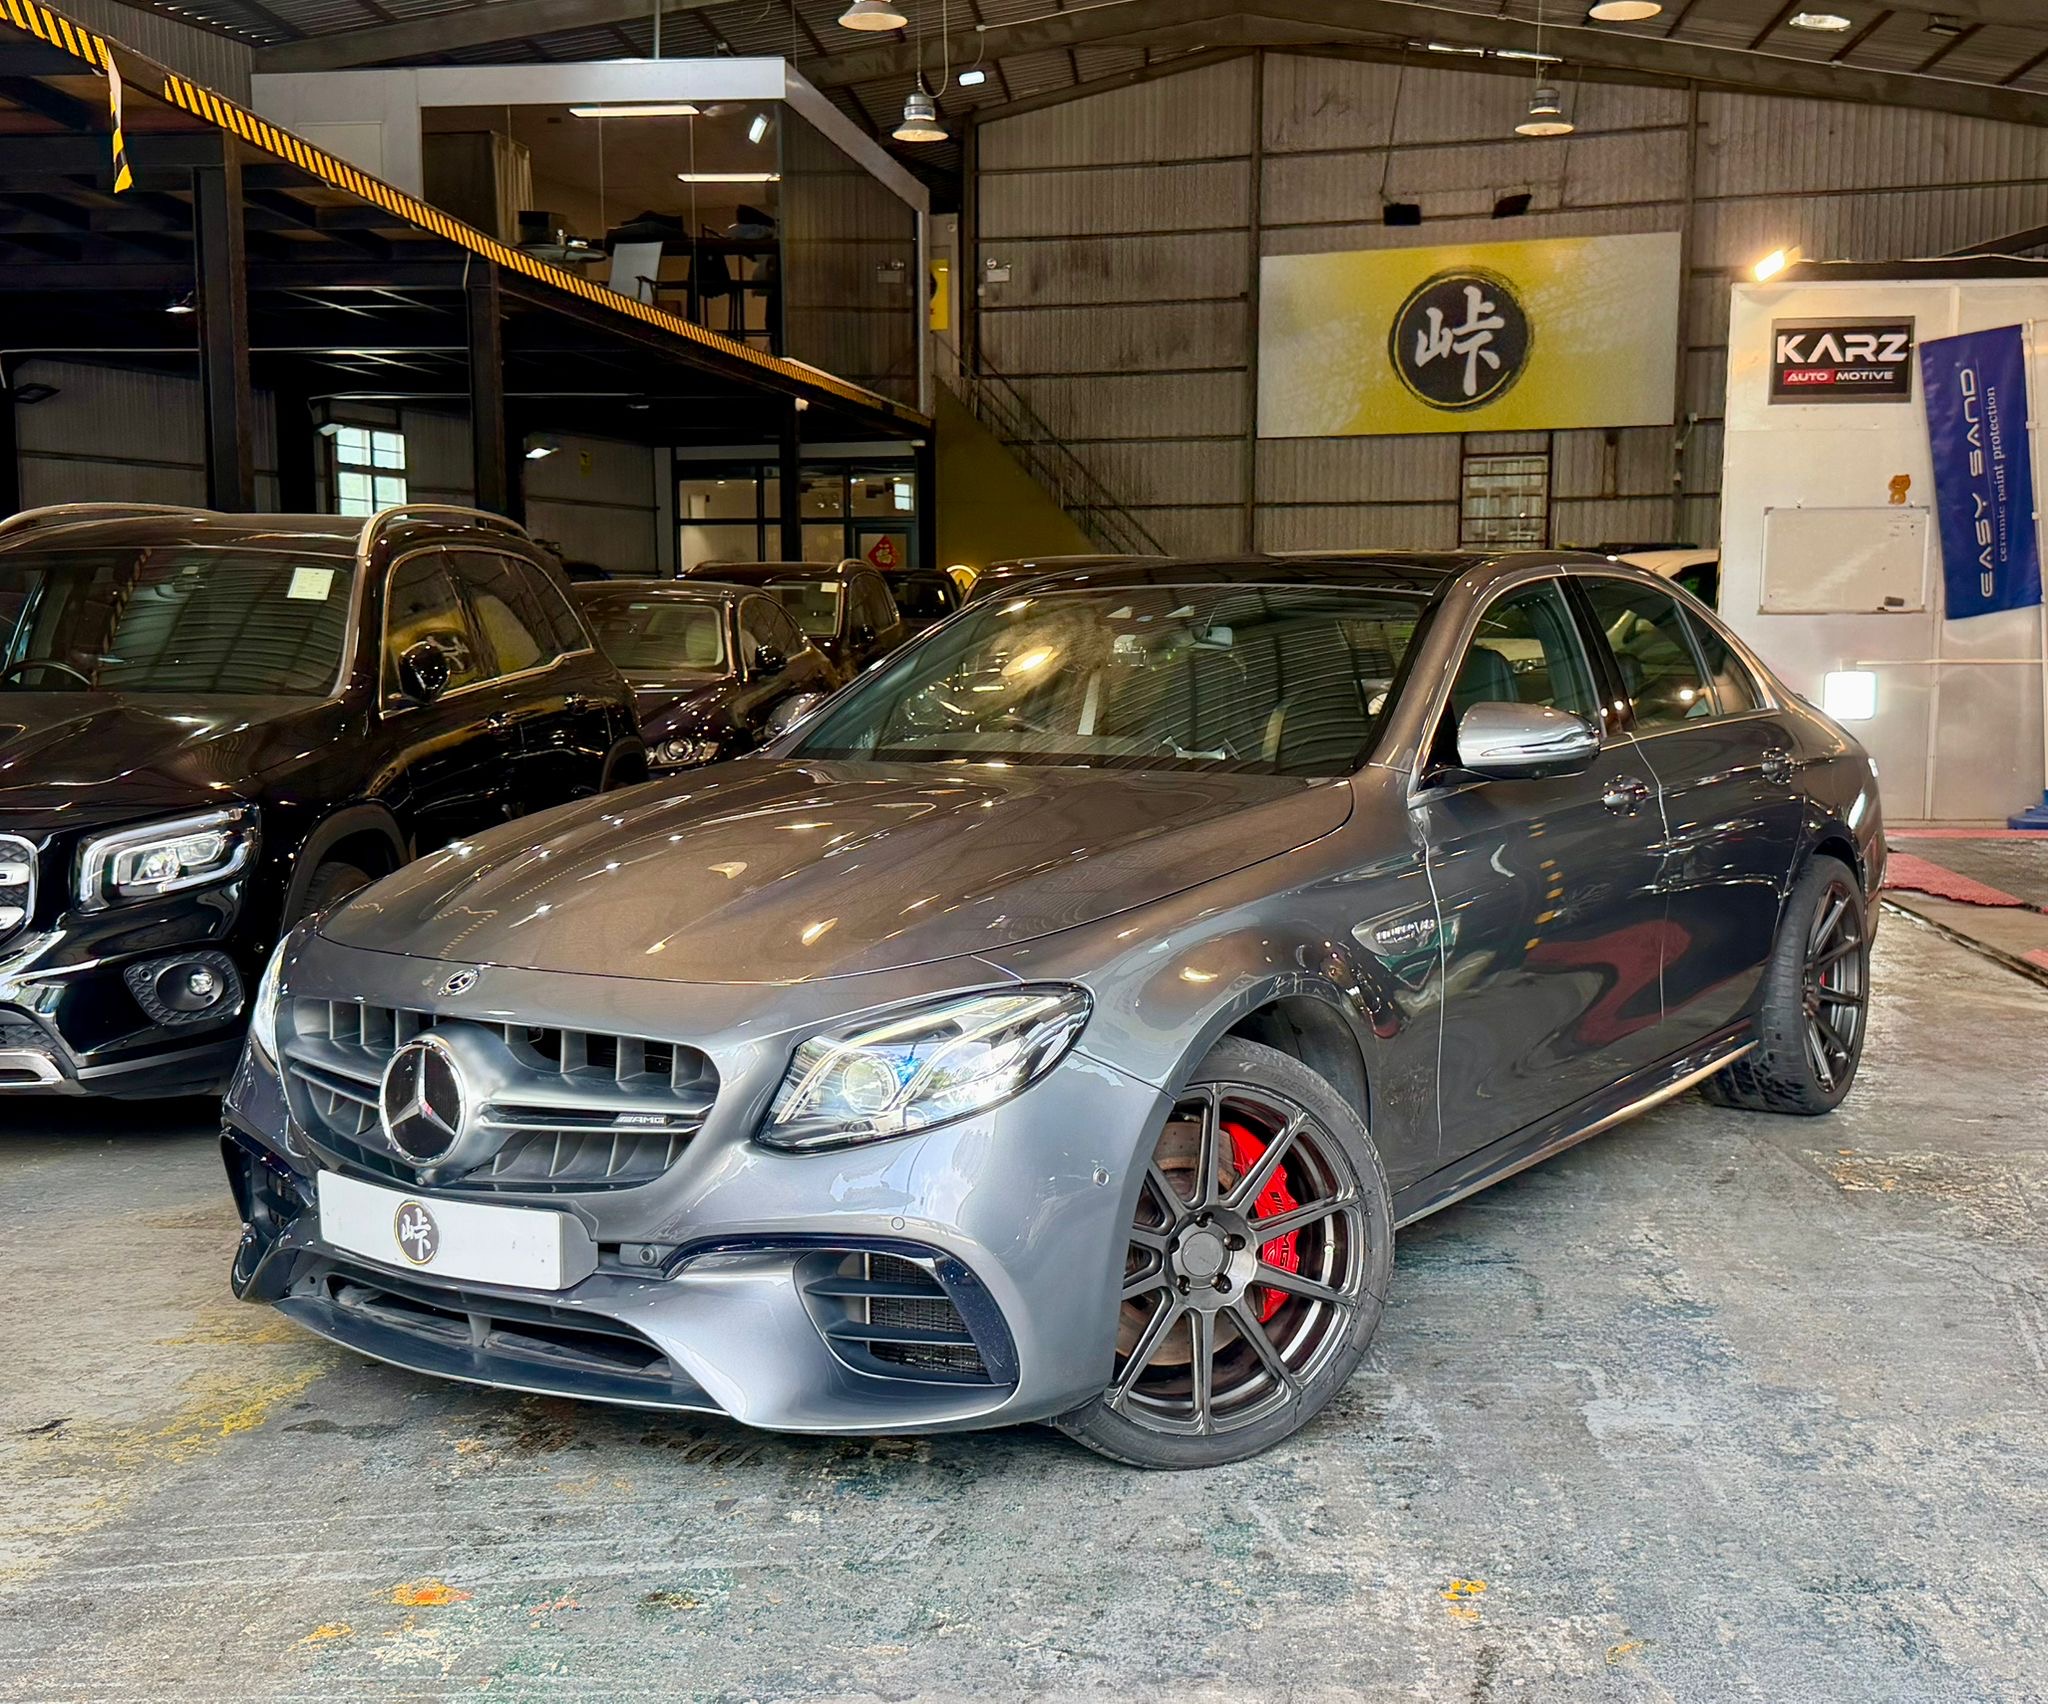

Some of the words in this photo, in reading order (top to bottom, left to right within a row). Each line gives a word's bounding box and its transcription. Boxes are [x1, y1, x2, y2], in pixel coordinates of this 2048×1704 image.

[1415, 285, 1505, 396] 峠
[1776, 333, 1908, 363] KARZ
[1787, 372, 1828, 382] AUTO
[1836, 371, 1894, 380] MOTIVE
[1960, 369, 1983, 477] SAND
[1986, 387, 2005, 460] protection
[1994, 464, 2007, 502] paint
[1971, 492, 1993, 597] EASY
[1997, 506, 2008, 562] ceramic
[401, 1207, 431, 1260] 峠
